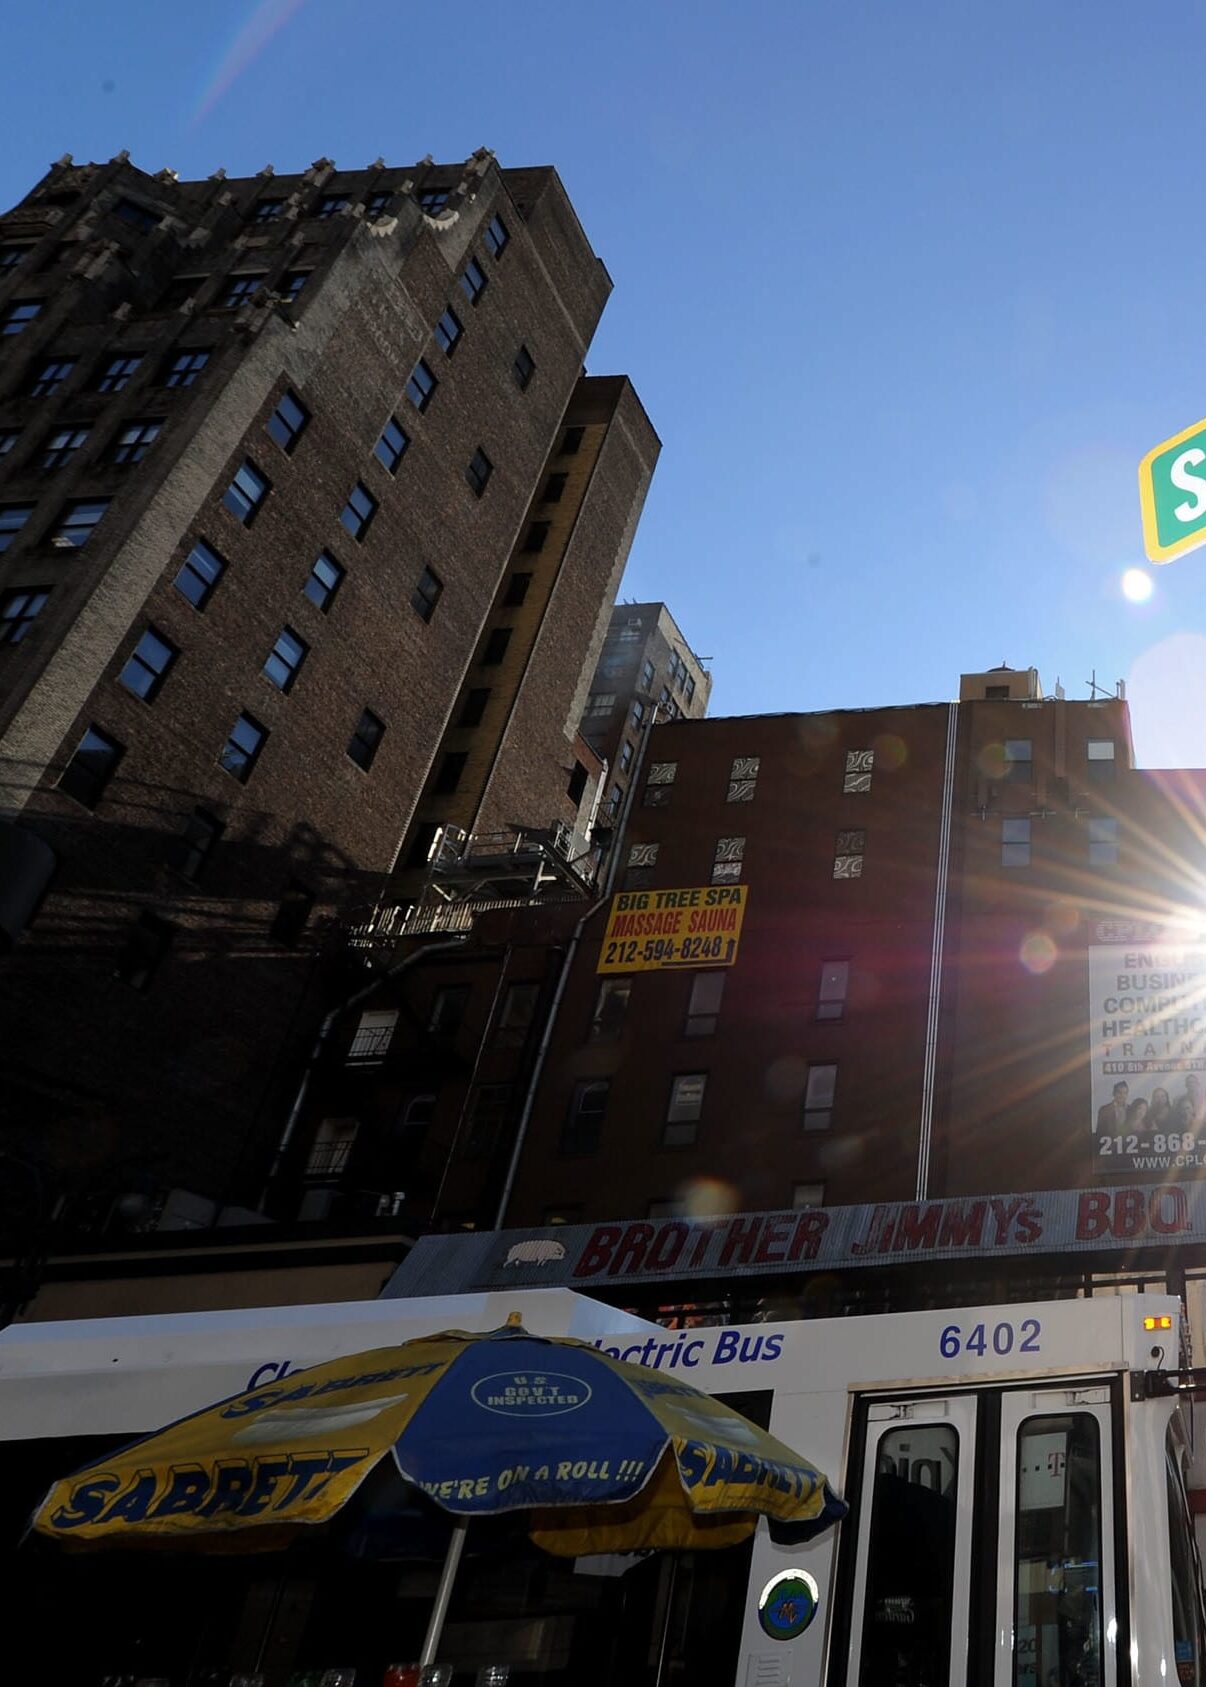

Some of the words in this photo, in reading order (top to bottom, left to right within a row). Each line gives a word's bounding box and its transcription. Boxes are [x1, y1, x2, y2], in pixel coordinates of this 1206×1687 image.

[617, 893, 650, 911] BIG
[656, 890, 702, 909] TREE
[704, 887, 742, 906] SPA
[611, 910, 683, 938] MASSAGE
[688, 908, 738, 933] SAUNA
[605, 936, 722, 964] 212-594-8248
[572, 1211, 830, 1278] BROTHER
[1075, 1186, 1193, 1241] BBQ
[594, 1332, 705, 1369] ectric
[712, 1330, 785, 1365] Bus
[939, 1319, 1042, 1359] 6402
[487, 1395, 579, 1405] INSPECTED
[51, 1449, 370, 1528] SABRETT
[498, 1466, 529, 1490] ON
[534, 1466, 549, 1480] A
[556, 1460, 609, 1480] ROLL
